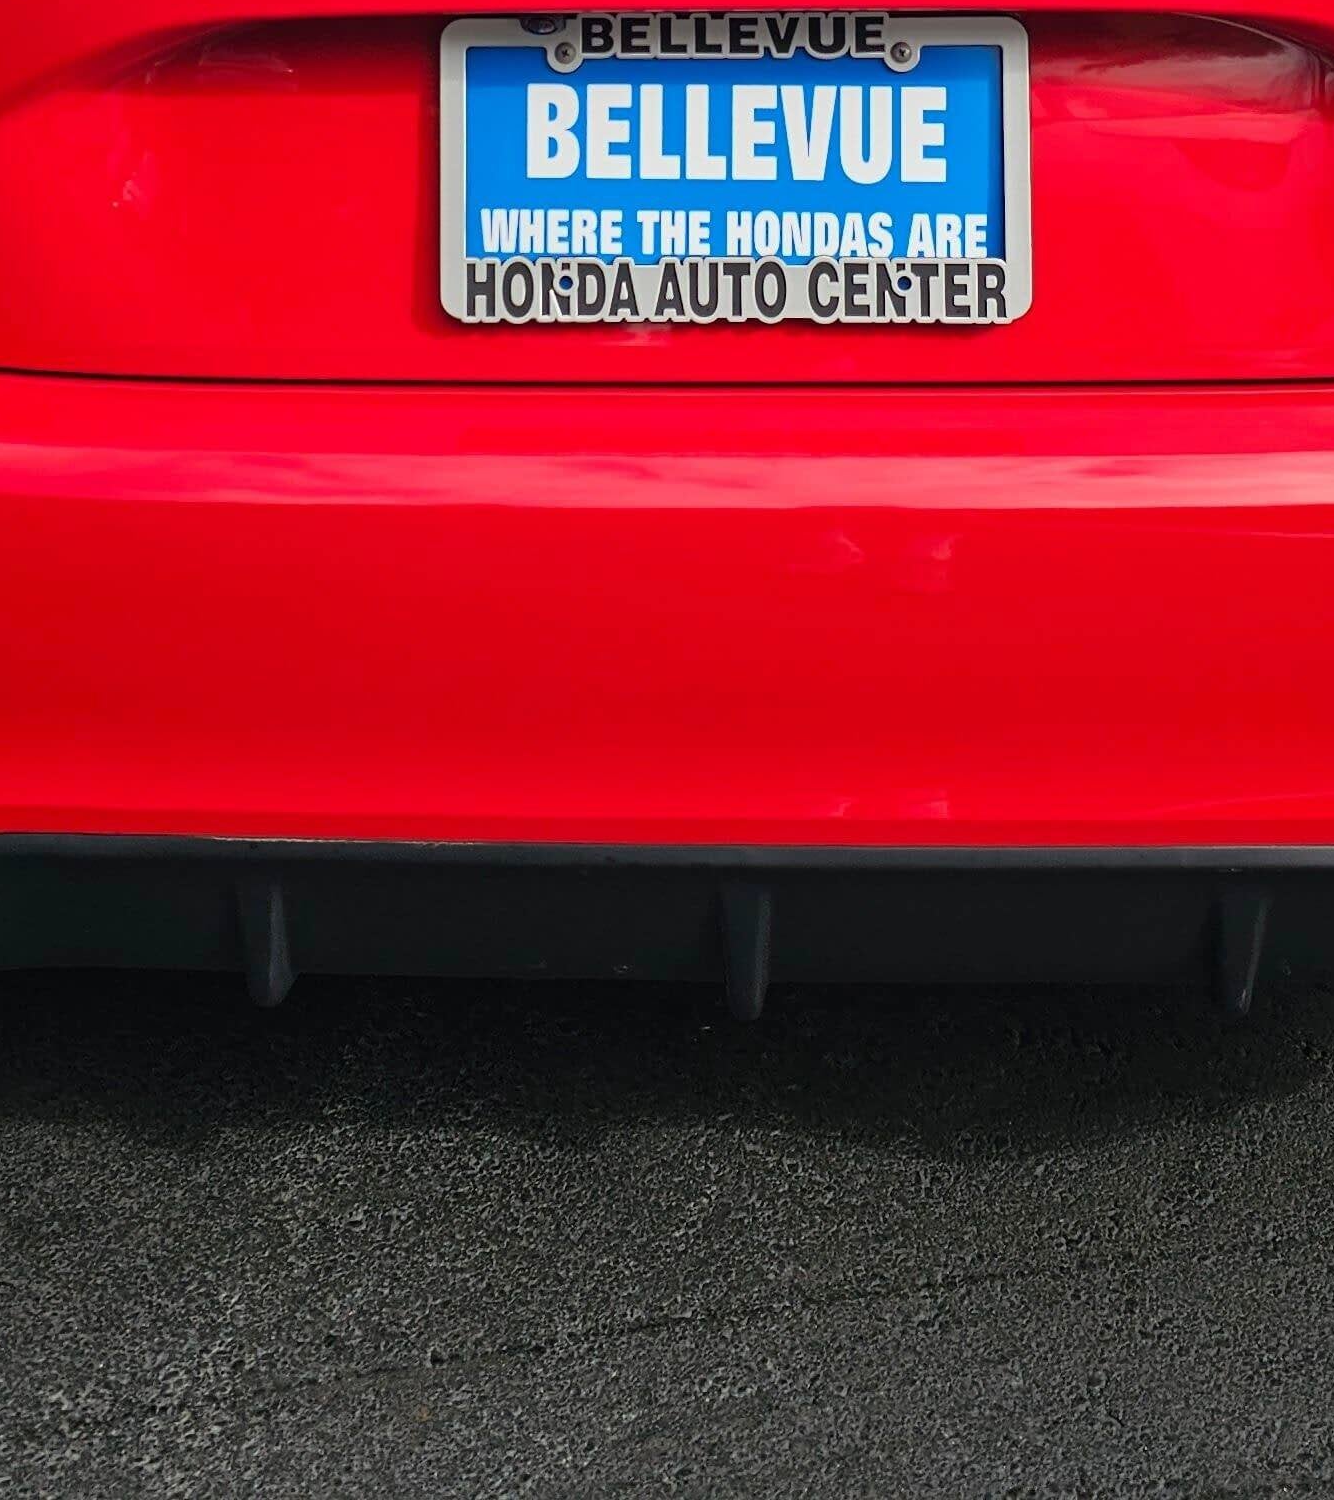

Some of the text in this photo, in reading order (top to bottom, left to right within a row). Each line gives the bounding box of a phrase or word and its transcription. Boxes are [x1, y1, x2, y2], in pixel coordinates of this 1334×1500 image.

[581, 15, 886, 55] BELLEVUE
[526, 83, 947, 184] BELLEVUE
[480, 208, 988, 258] WHERE THE HONDAS ARE
[467, 260, 1008, 318] HONDA AUTO CENTER
